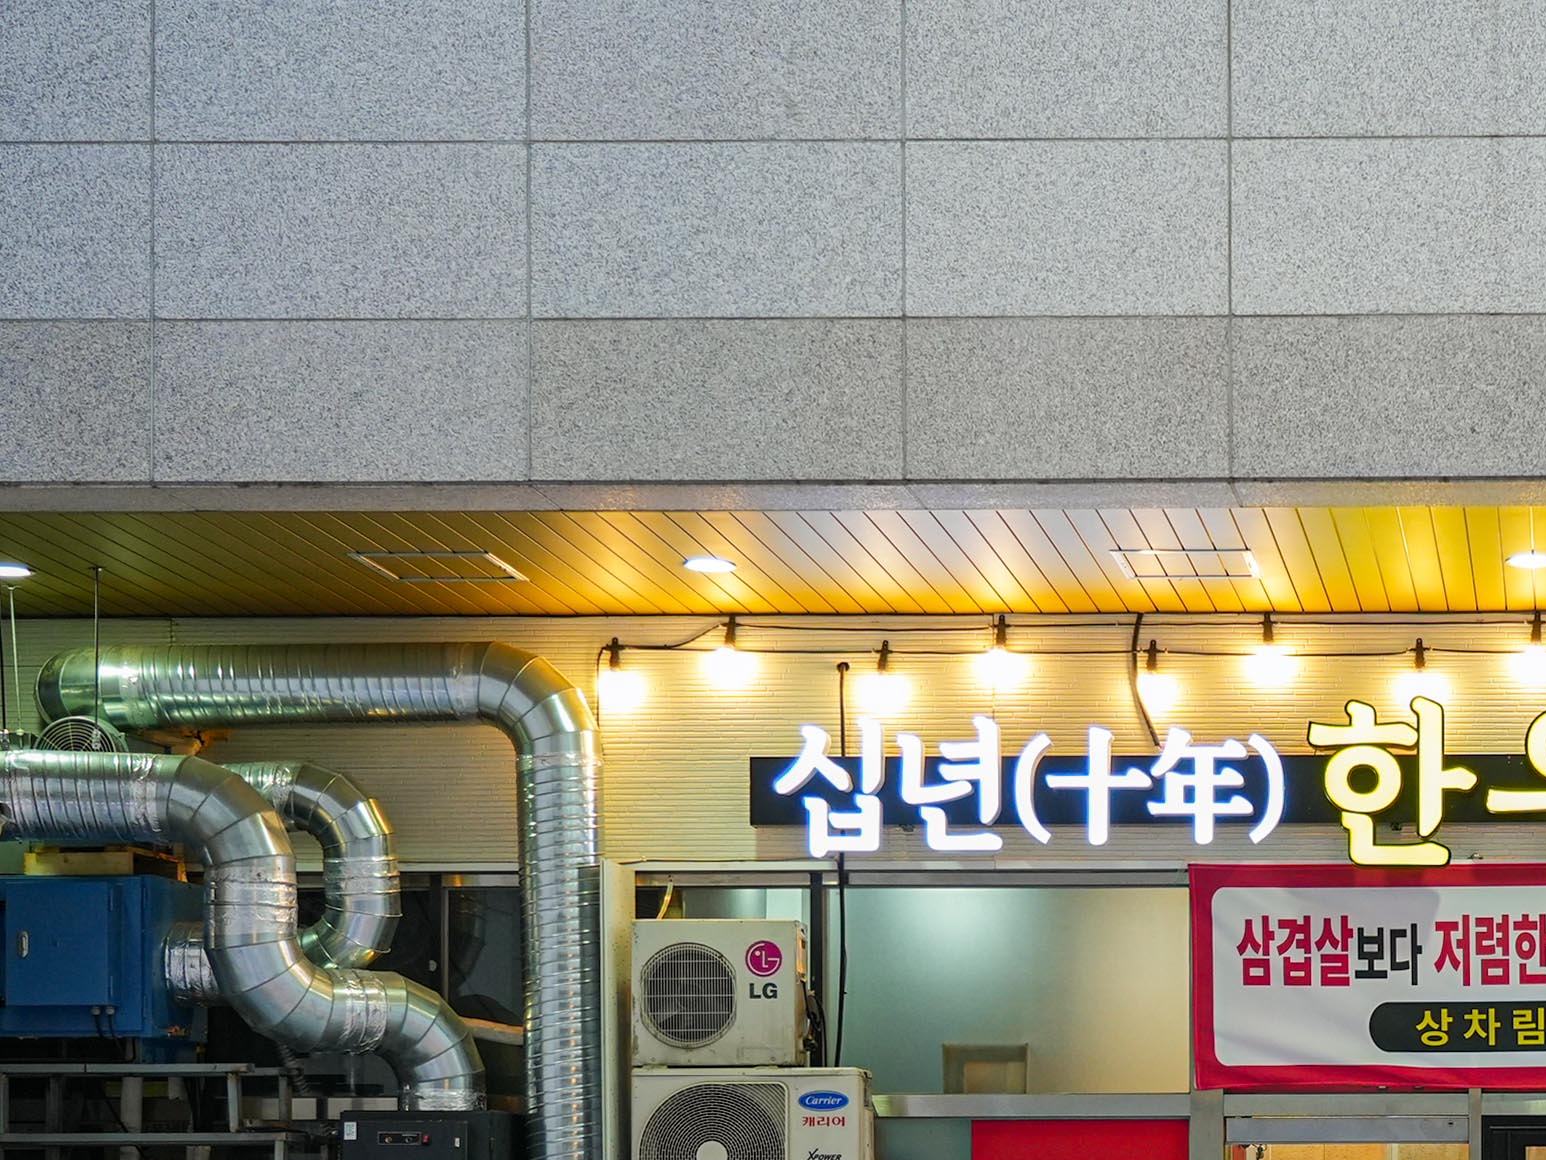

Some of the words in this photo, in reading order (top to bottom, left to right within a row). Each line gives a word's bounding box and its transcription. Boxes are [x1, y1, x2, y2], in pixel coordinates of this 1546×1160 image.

[773, 715, 1286, 857] 십년(十年)
[1236, 914, 1422, 987] 삼겹살보다
[749, 983, 778, 999] LG
[805, 1096, 842, 1105] Carrier
[802, 1116, 846, 1127] 캐리어
